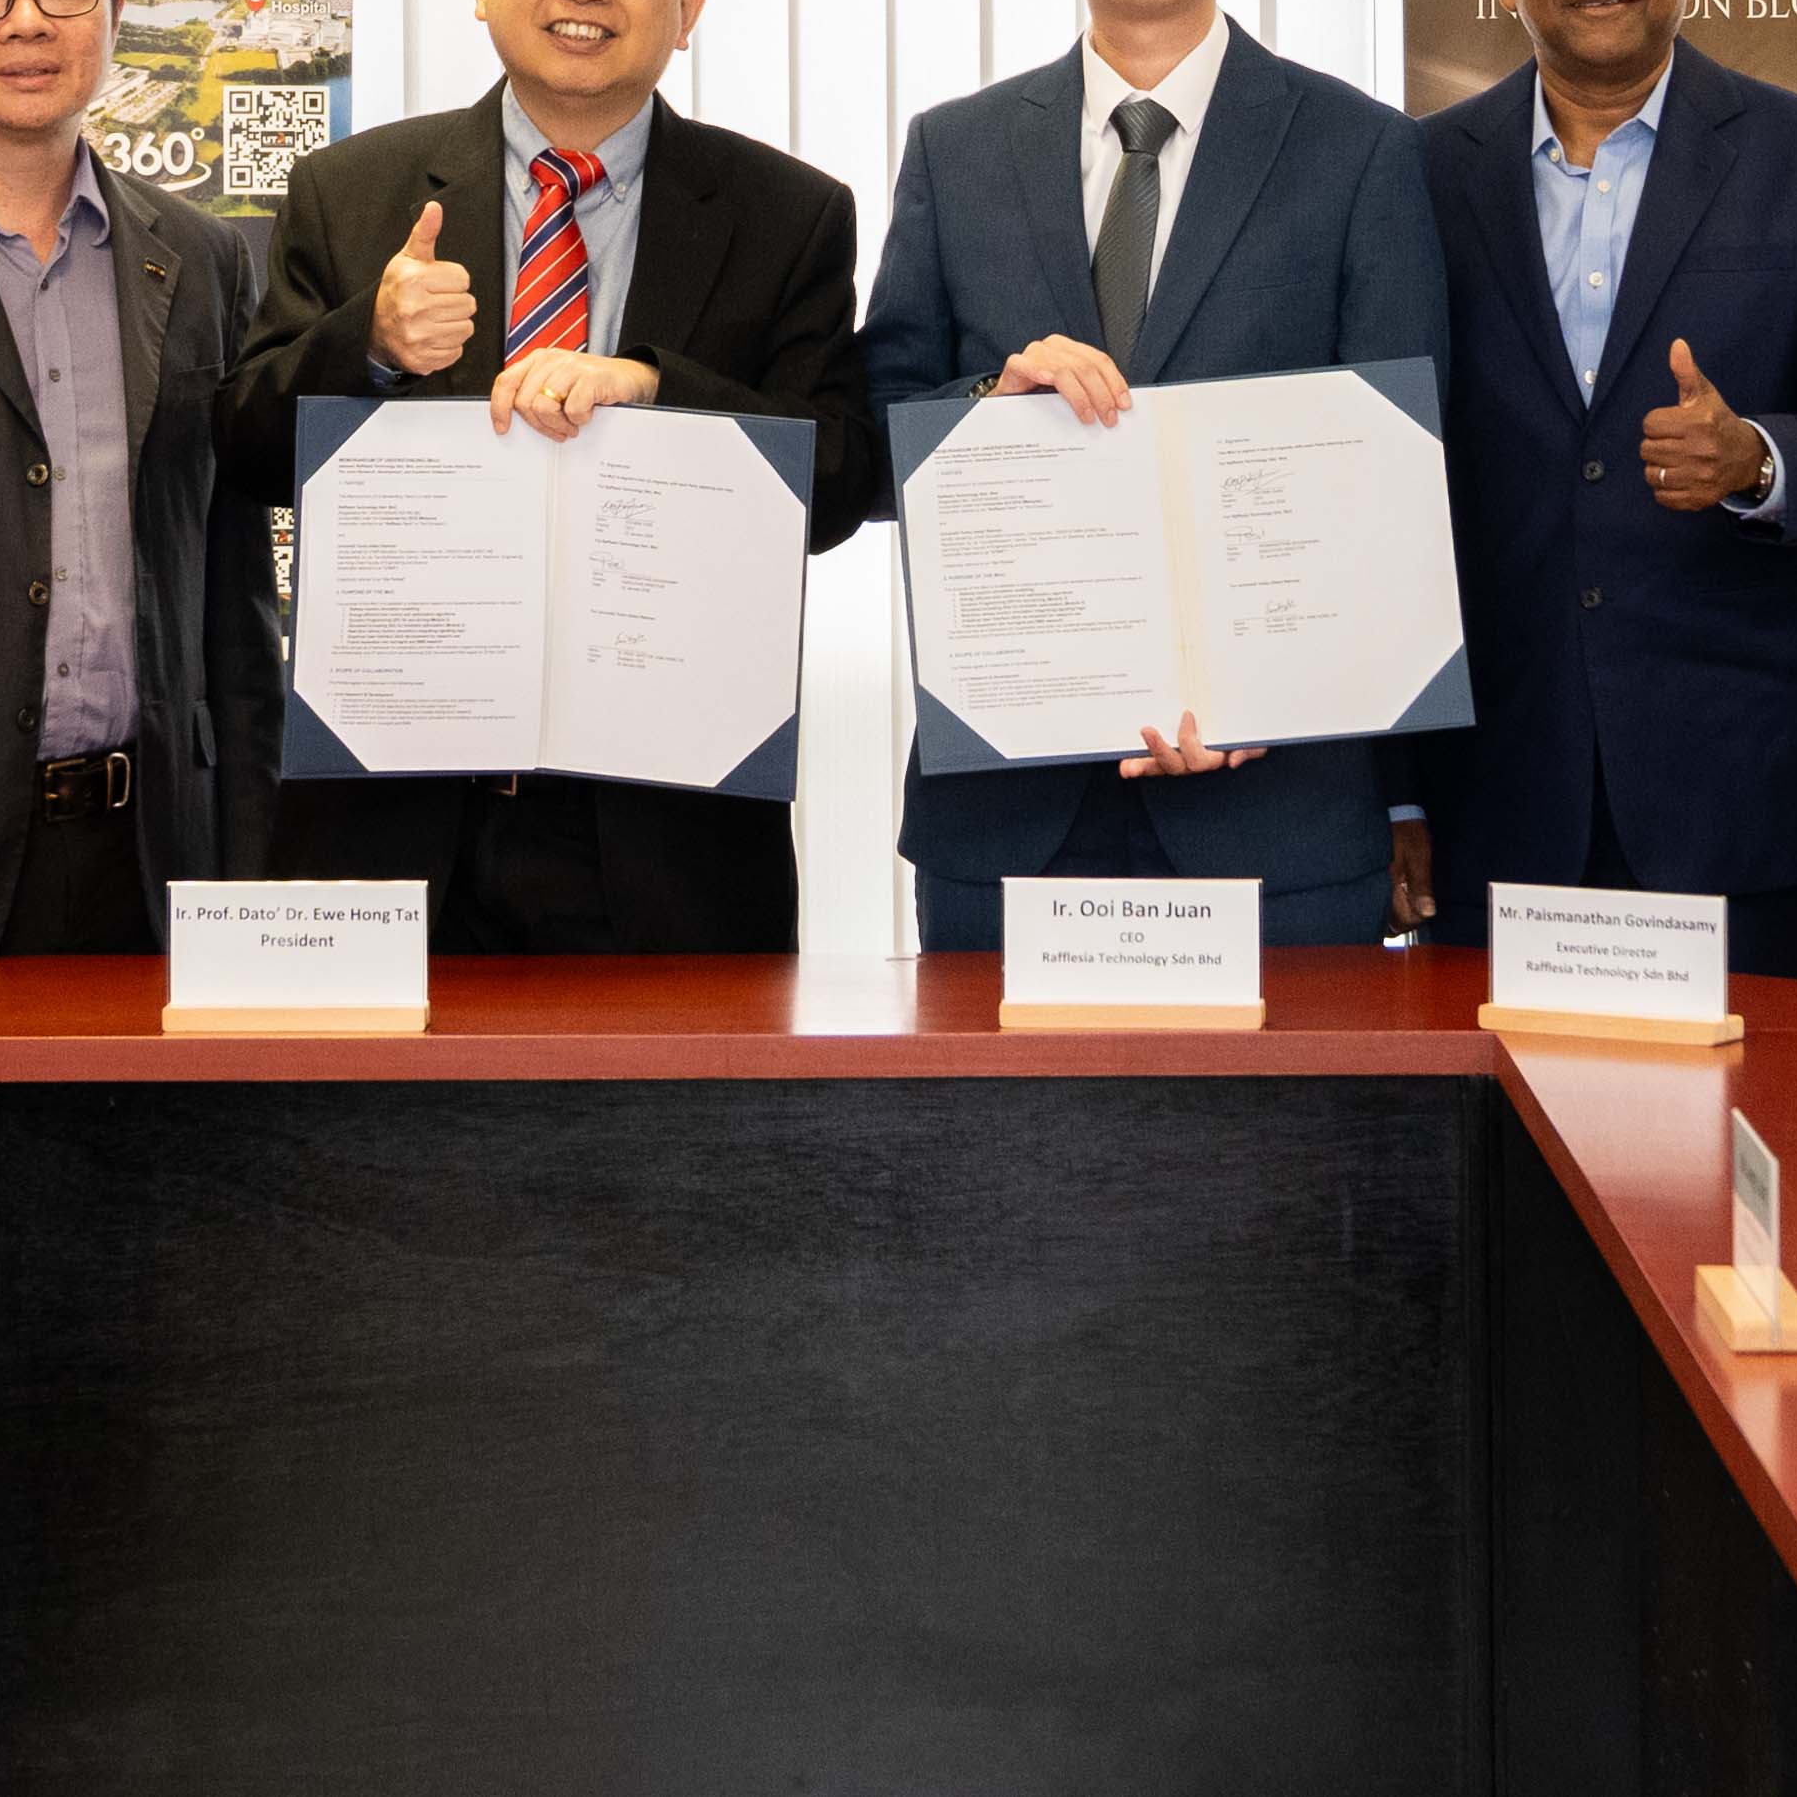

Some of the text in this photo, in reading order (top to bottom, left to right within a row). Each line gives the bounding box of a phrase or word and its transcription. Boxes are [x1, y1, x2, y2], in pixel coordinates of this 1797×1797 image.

[272, 1, 330, 14] Hospital
[262, 135, 294, 145] UTAR
[176, 907, 191, 919] Ir.
[198, 907, 232, 920] Prof.
[286, 908, 307, 920] Dr.
[314, 908, 345, 920] Ewe
[351, 908, 390, 924] Hong
[395, 908, 419, 921] Tat
[1054, 900, 1211, 918] Ir. Ooi Ban Juan
[1500, 907, 1521, 919] Mr.
[1625, 914, 1716, 934] Govindasamy
[261, 934, 334, 947] President
[1120, 932, 1144, 943] CEO
[1557, 942, 1657, 958] Executive Director
[1043, 952, 1221, 967] Rafflesia Technology Sdn Bhd
[1526, 961, 1689, 982] Rafflesia Technology Sdn Bhd
